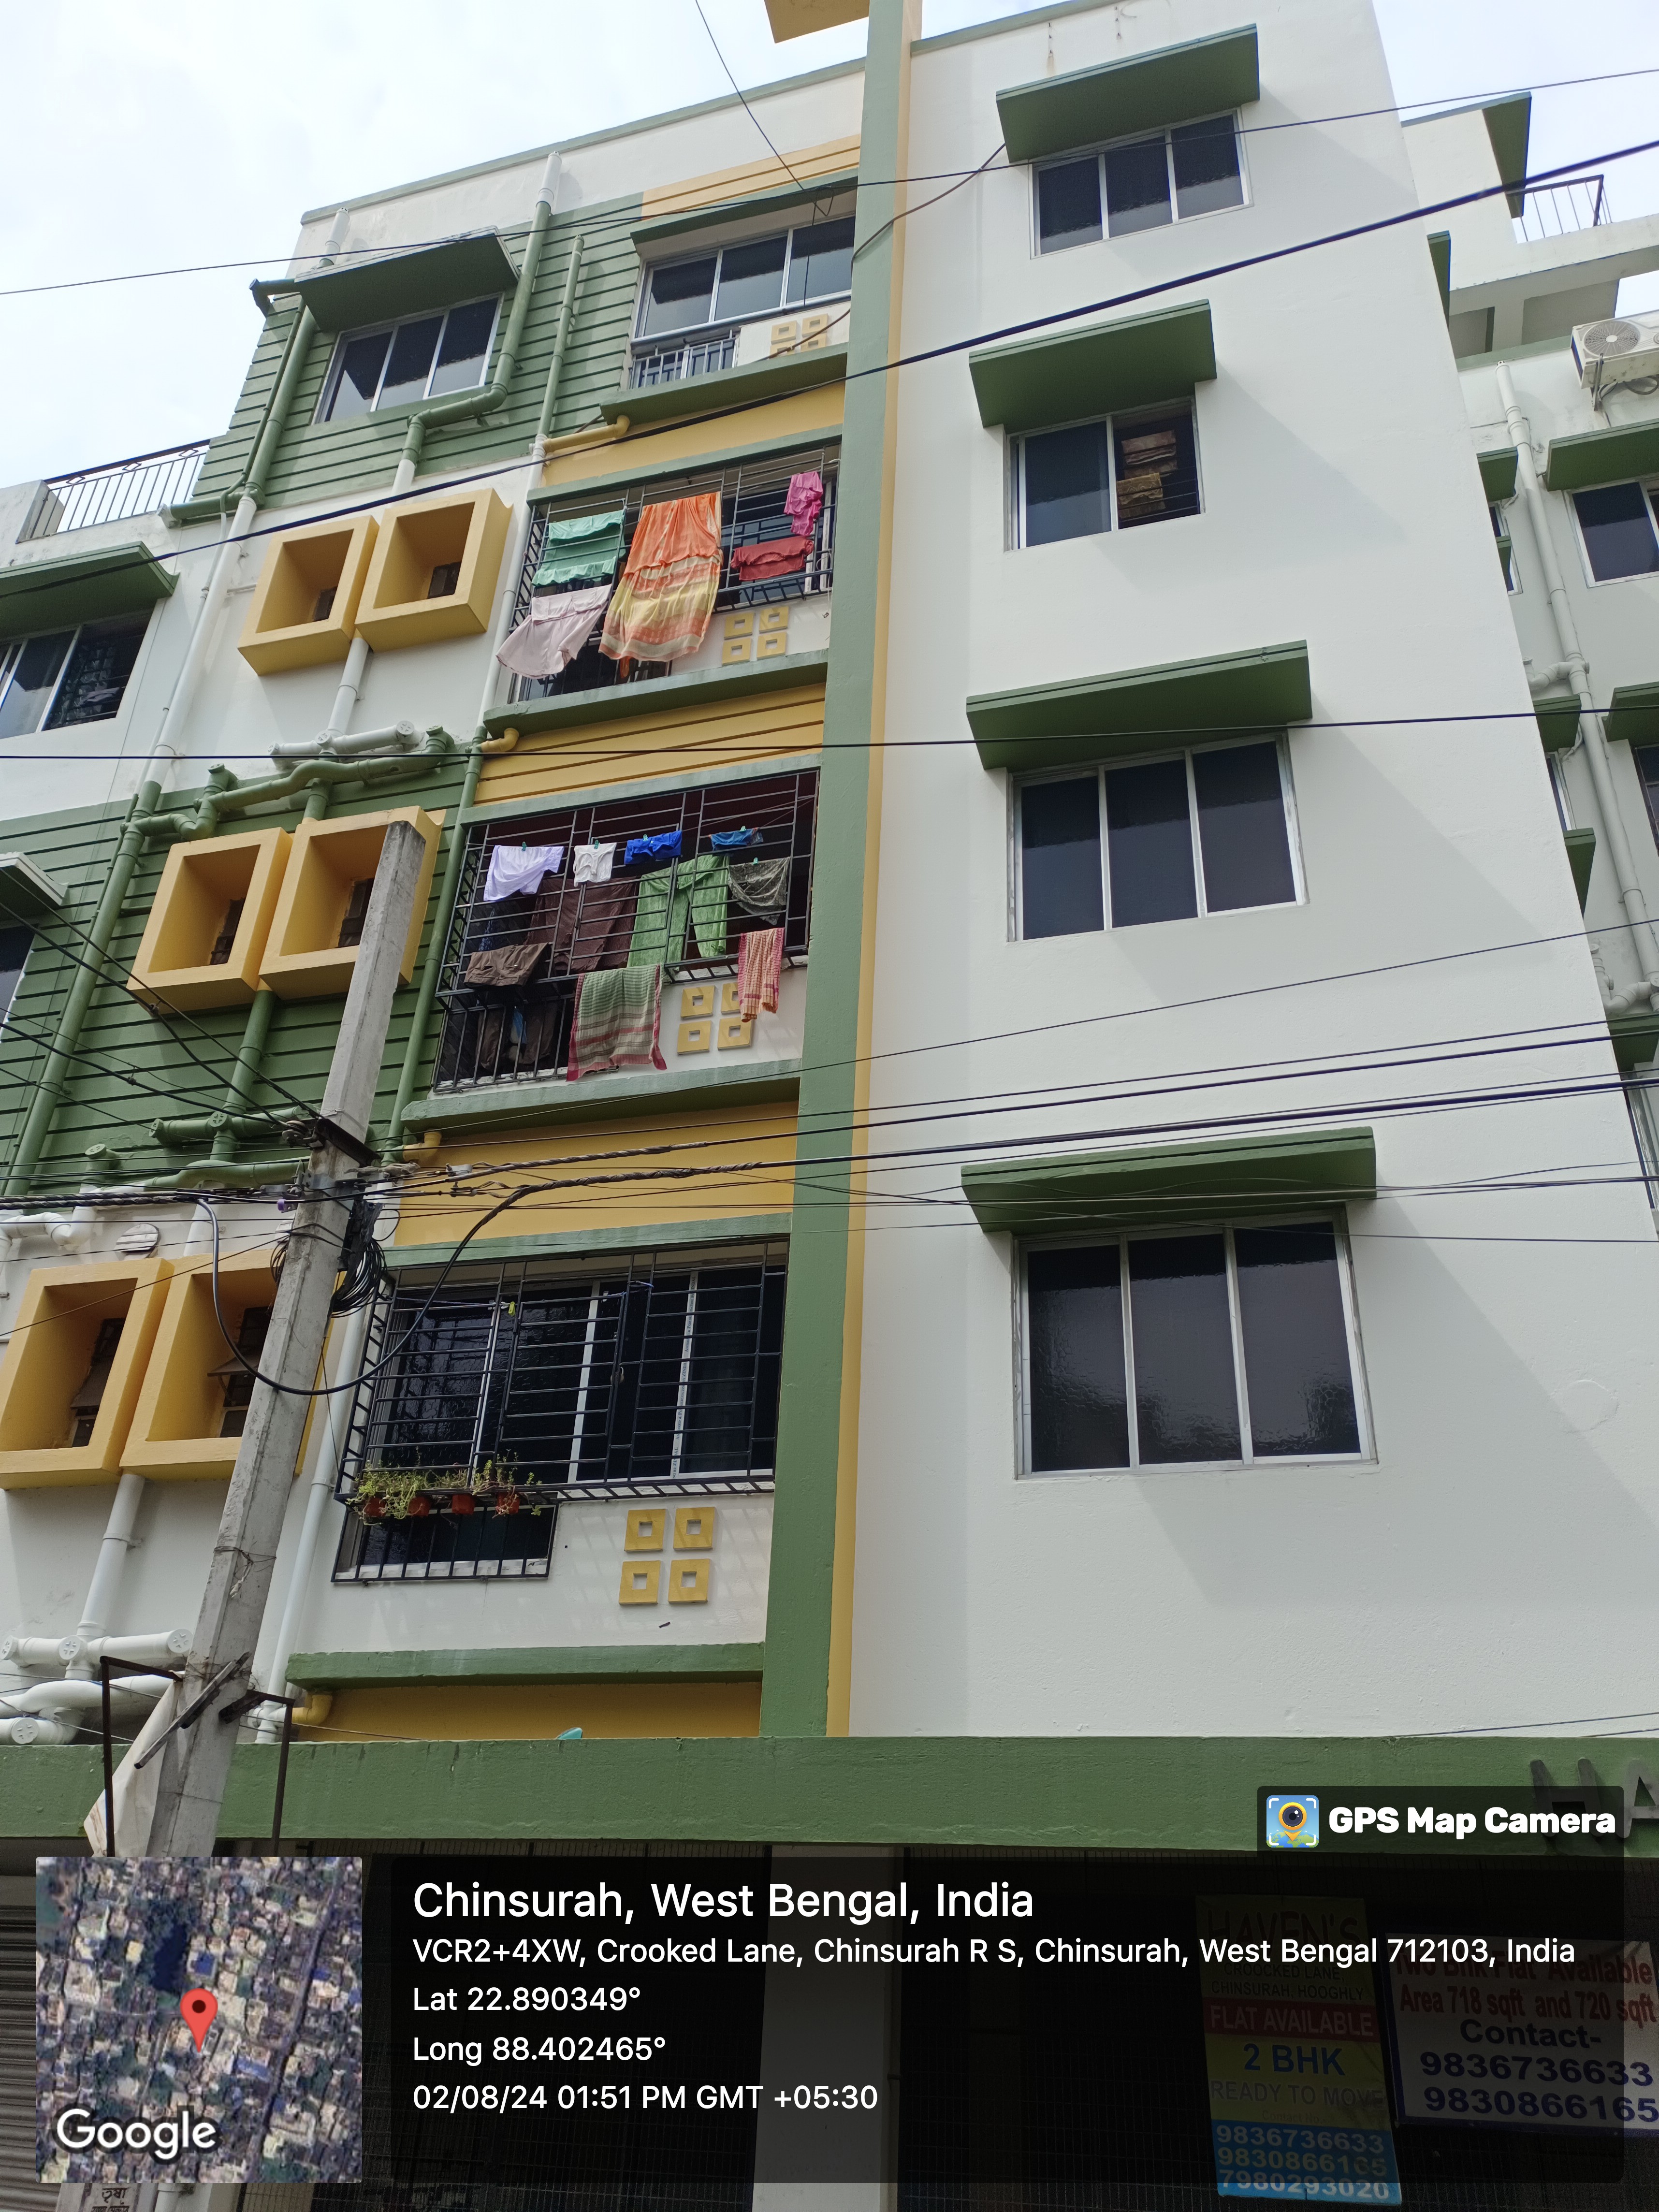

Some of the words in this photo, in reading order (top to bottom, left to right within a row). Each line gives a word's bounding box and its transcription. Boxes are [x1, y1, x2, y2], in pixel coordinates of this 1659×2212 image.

[1224, 1962, 1300, 1978] CROOCKED
[1305, 1964, 1345, 1982] LANE,
[1548, 1952, 1653, 1984] Available
[1211, 1980, 1294, 1998] CHINSURAH,
[1297, 1984, 1364, 2001] HOOGHLY
[1400, 1984, 1444, 2013] Area
[1447, 1986, 1482, 2015] 718
[1486, 1988, 1527, 2022] sqft
[1535, 1990, 1572, 2019] and
[1575, 1991, 1611, 2021] 720
[1616, 1993, 1658, 2028] sqft
[1210, 2005, 1257, 2030] FLAT
[1263, 2008, 1374, 2037] AVAILABLE
[1243, 2043, 1261, 2071] 2
[1272, 2044, 1346, 2076] BHK
[1420, 2052, 1653, 2086] 9836736633
[1210, 2080, 1281, 2103] READY
[1287, 2084, 1316, 2105] TO
[1323, 2086, 1386, 2110] MOVE
[1424, 2086, 1659, 2122] 9830866165
[1216, 2125, 1384, 2154] 9836736633
[1217, 2147, 1387, 2177] 9830866165
[1219, 2169, 1389, 2199] 7980293020
